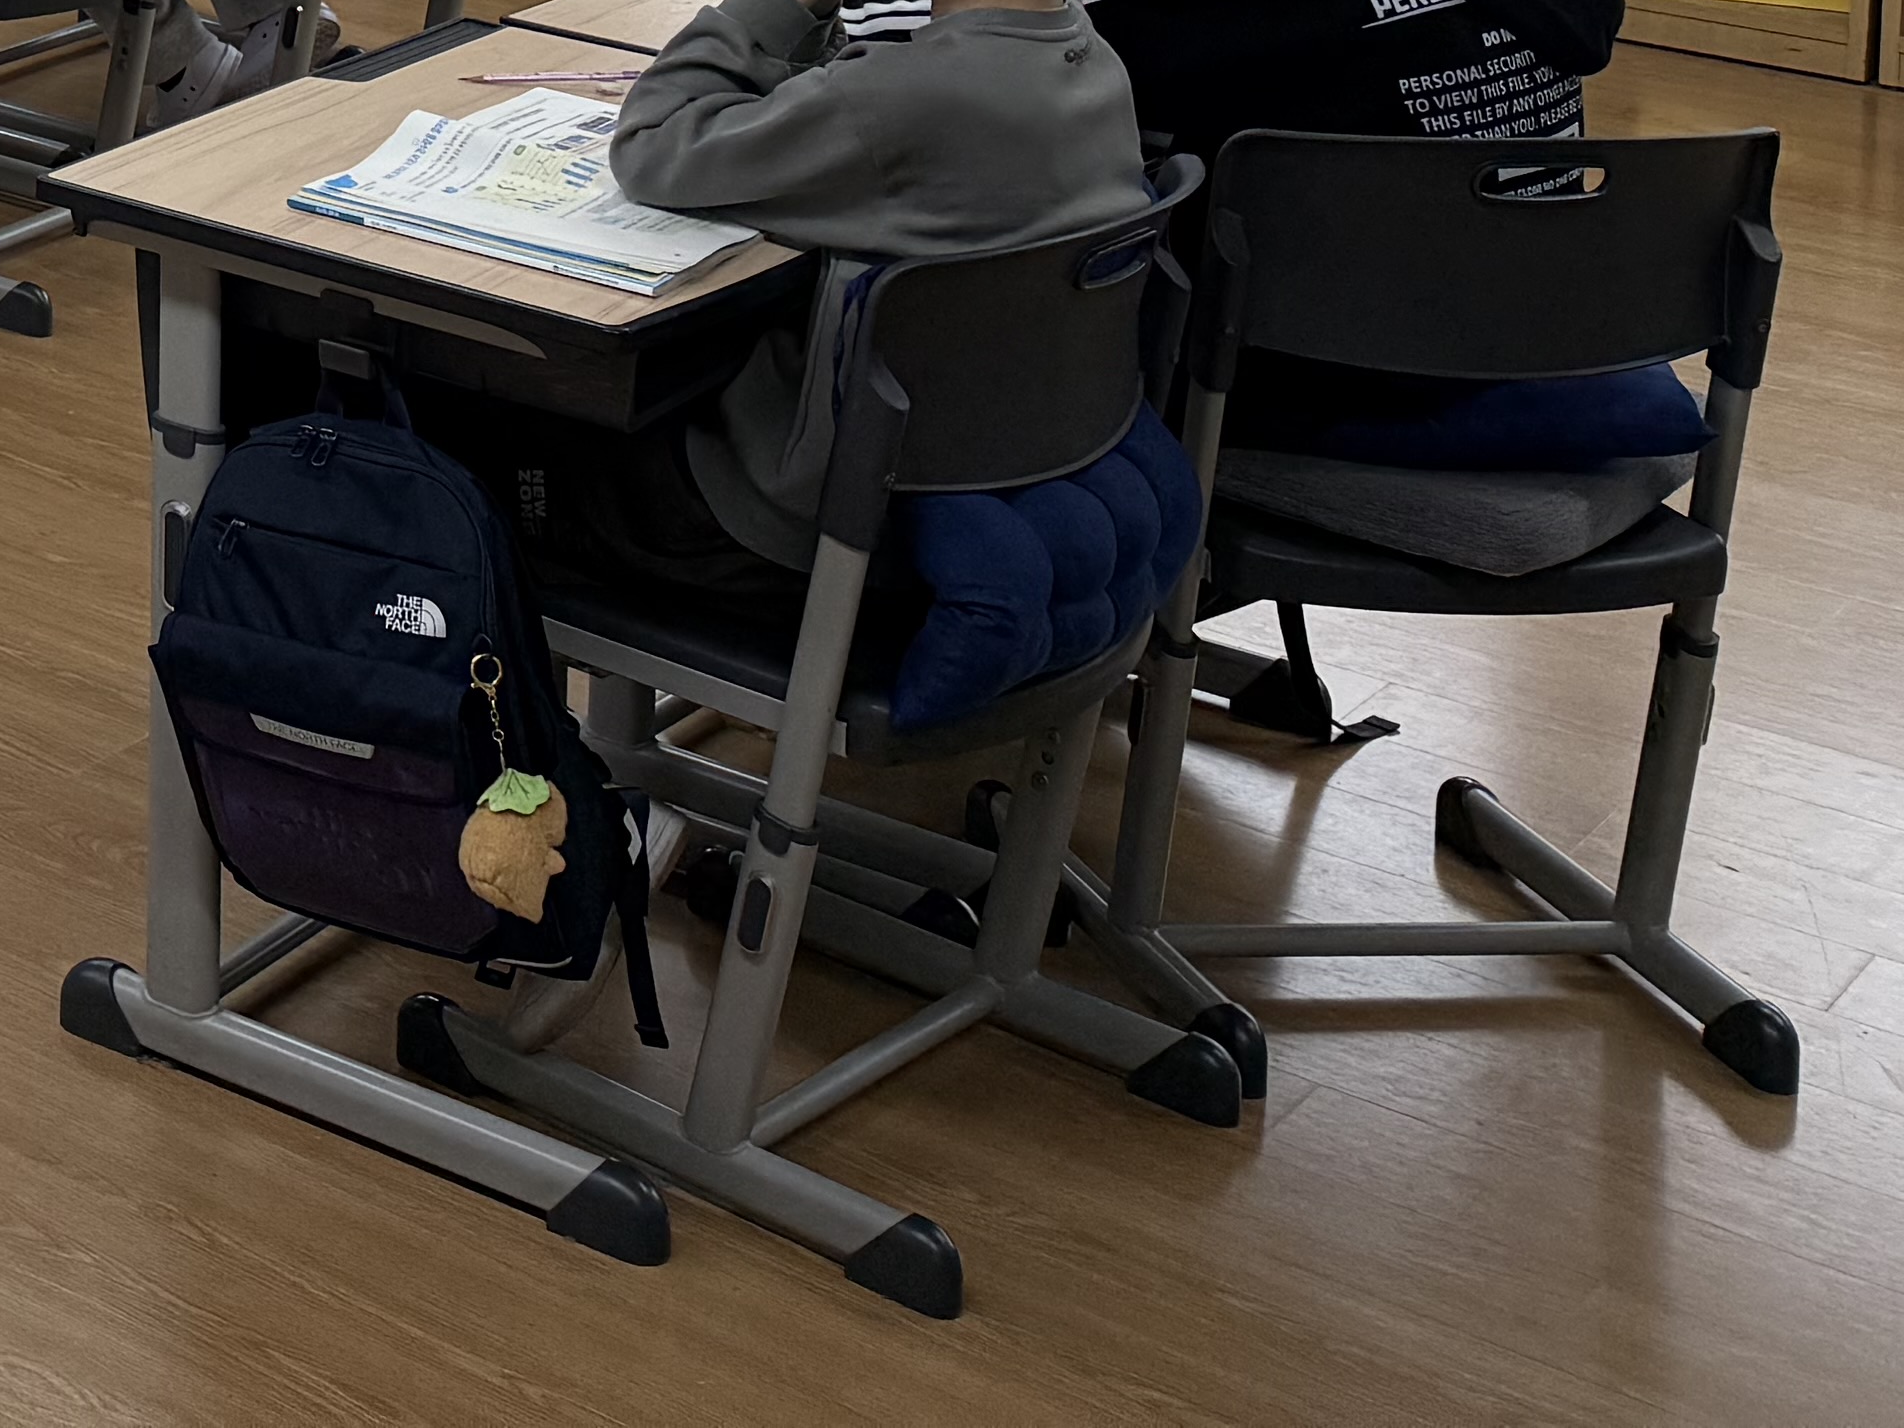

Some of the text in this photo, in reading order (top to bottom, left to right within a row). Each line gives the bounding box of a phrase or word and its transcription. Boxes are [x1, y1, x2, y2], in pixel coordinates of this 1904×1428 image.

[1398, 64, 1486, 94] PERSONAL
[1404, 98, 1430, 115] TO
[1432, 88, 1478, 110] VIEW
[1480, 80, 1507, 100] THIS
[1420, 113, 1461, 133] THIS
[1463, 106, 1494, 126] FILE
[1494, 100, 1509, 118] BY
[1512, 93, 1534, 114] ANY
[1511, 116, 1539, 135] YOU.
[532, 469, 547, 518] NEW
[374, 602, 421, 622] NORTH
[396, 593, 422, 610] THE
[385, 616, 421, 635] FACE
